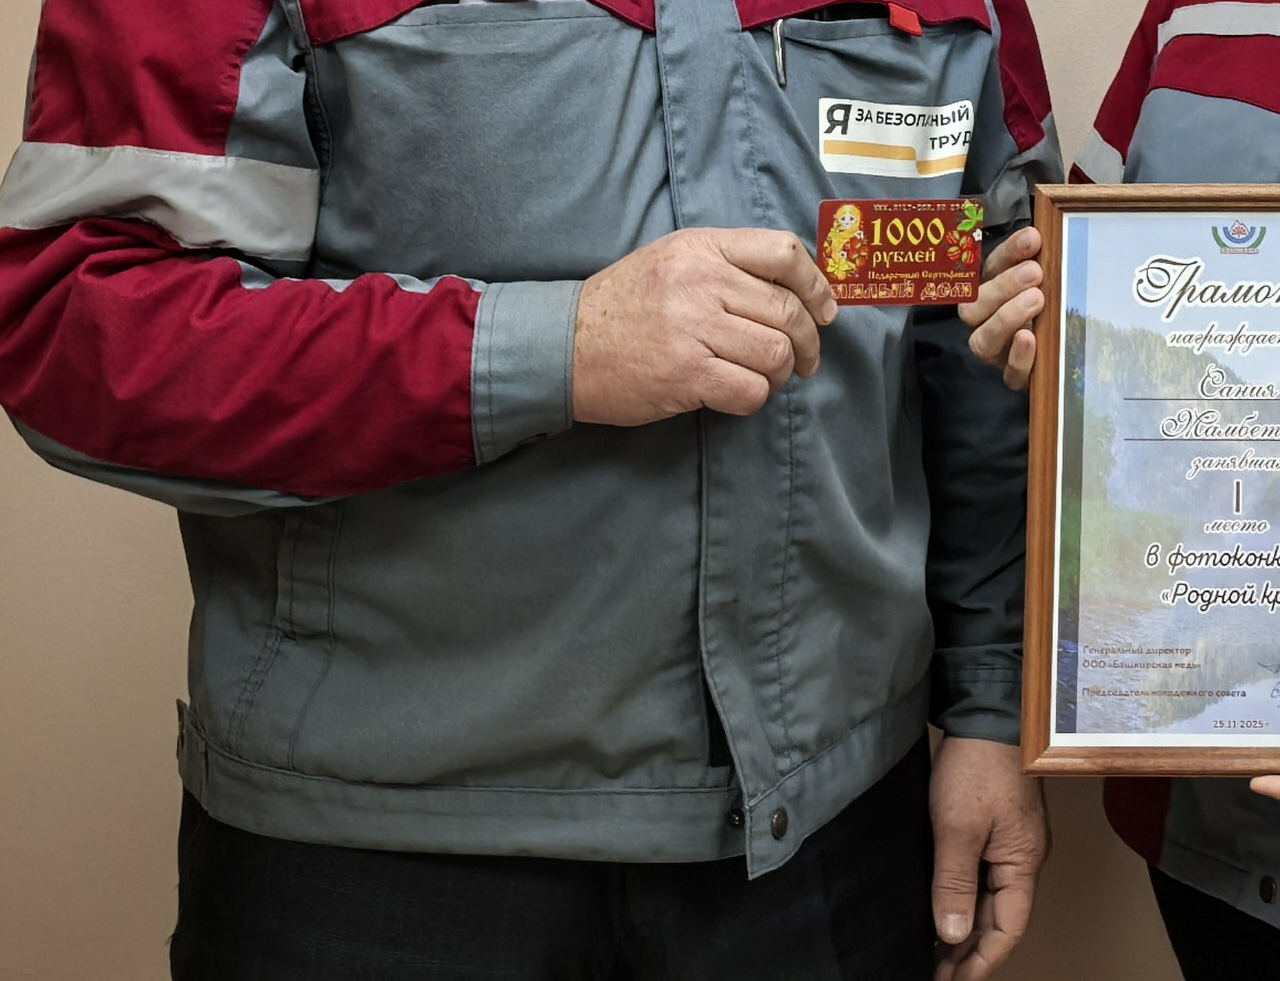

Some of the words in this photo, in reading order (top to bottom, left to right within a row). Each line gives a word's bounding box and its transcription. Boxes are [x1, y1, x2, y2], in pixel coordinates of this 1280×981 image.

[824, 104, 852, 135] Я
[855, 108, 873, 123] ЗА
[876, 105, 970, 127] БЕЗОПНЫЙ
[929, 130, 972, 150] ТРУД
[870, 217, 945, 246] 1000
[1200, 365, 1279, 398] Сания
[1204, 519, 1270, 534] место
[1161, 582, 1257, 612] «Родной
